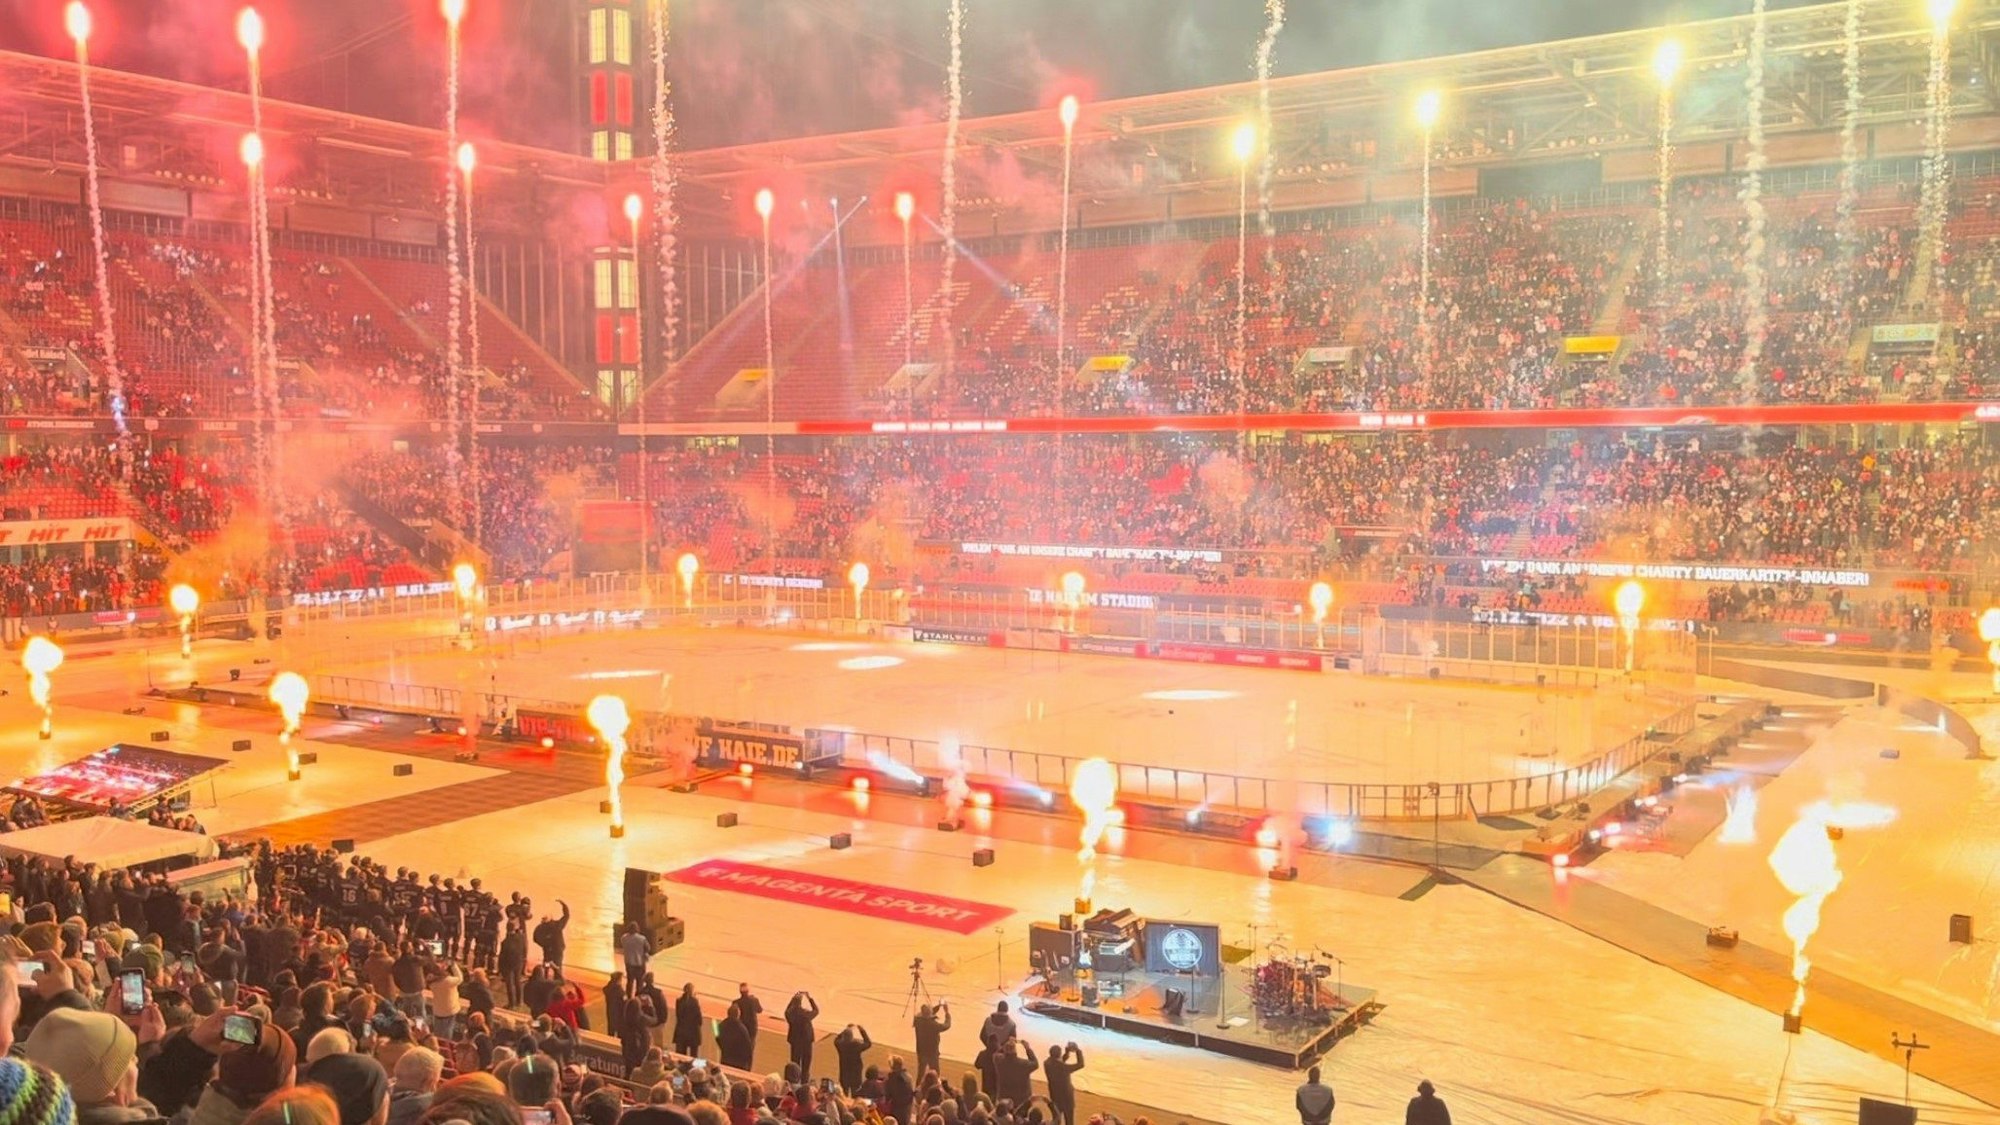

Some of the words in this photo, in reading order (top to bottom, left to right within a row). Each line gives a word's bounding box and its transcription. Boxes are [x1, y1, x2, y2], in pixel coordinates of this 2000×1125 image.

[1480, 560, 1524, 573] VLEN
[1635, 565, 1693, 579] CHARITY
[719, 739, 799, 770] HAIE.DE
[718, 872, 868, 904] MAGENTA
[865, 895, 981, 921] SPORT
